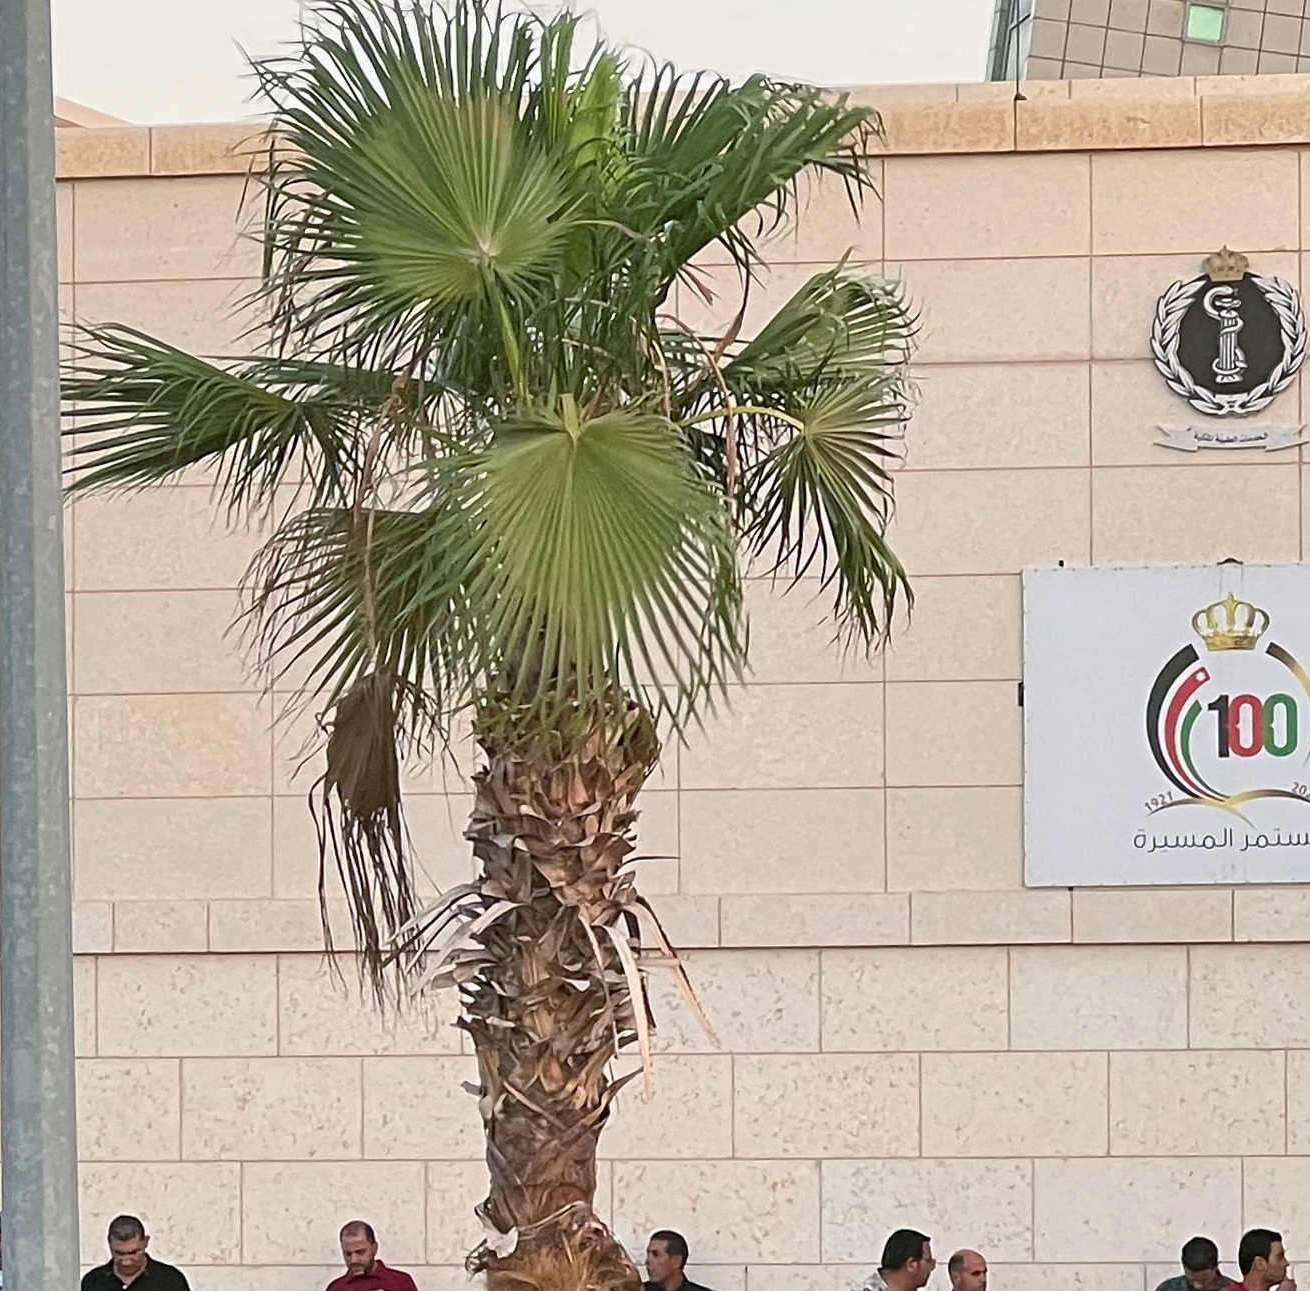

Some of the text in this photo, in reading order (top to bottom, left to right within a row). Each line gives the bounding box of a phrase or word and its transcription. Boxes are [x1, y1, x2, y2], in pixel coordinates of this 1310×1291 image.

[1207, 693, 1298, 758] 100
[1144, 790, 1174, 812] 1921
[1133, 827, 1233, 853] المسيرة
